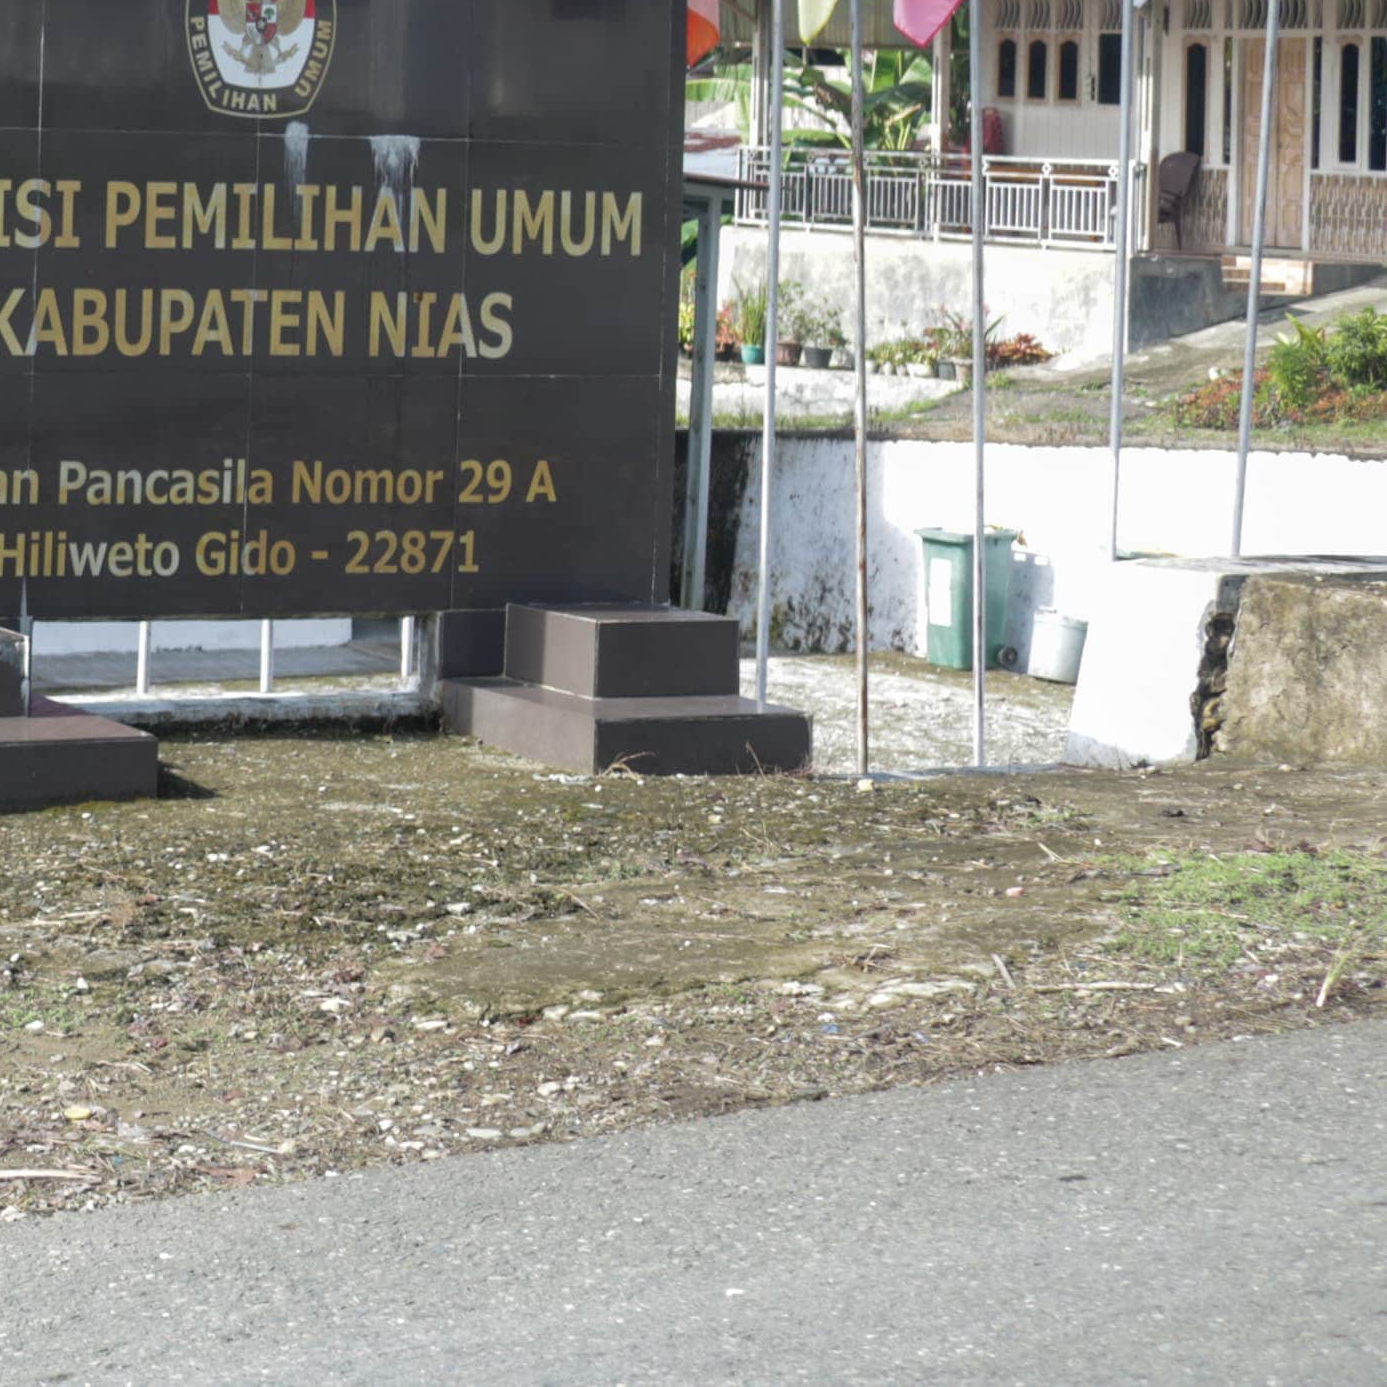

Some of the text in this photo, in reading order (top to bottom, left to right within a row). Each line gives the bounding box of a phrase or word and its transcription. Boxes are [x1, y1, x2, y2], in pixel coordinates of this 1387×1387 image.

[190, 15, 332, 111] PEMILIHAN UMUM
[104, 180, 447, 254] PEMILIHAN
[470, 188, 643, 257] UMUM
[369, 291, 513, 359] NIAS
[58, 458, 274, 505] Pancasila
[291, 460, 444, 504] Nomor
[458, 459, 513, 504] 29
[525, 460, 557, 503] A
[195, 529, 296, 576] Gido
[344, 529, 480, 574] 22871
